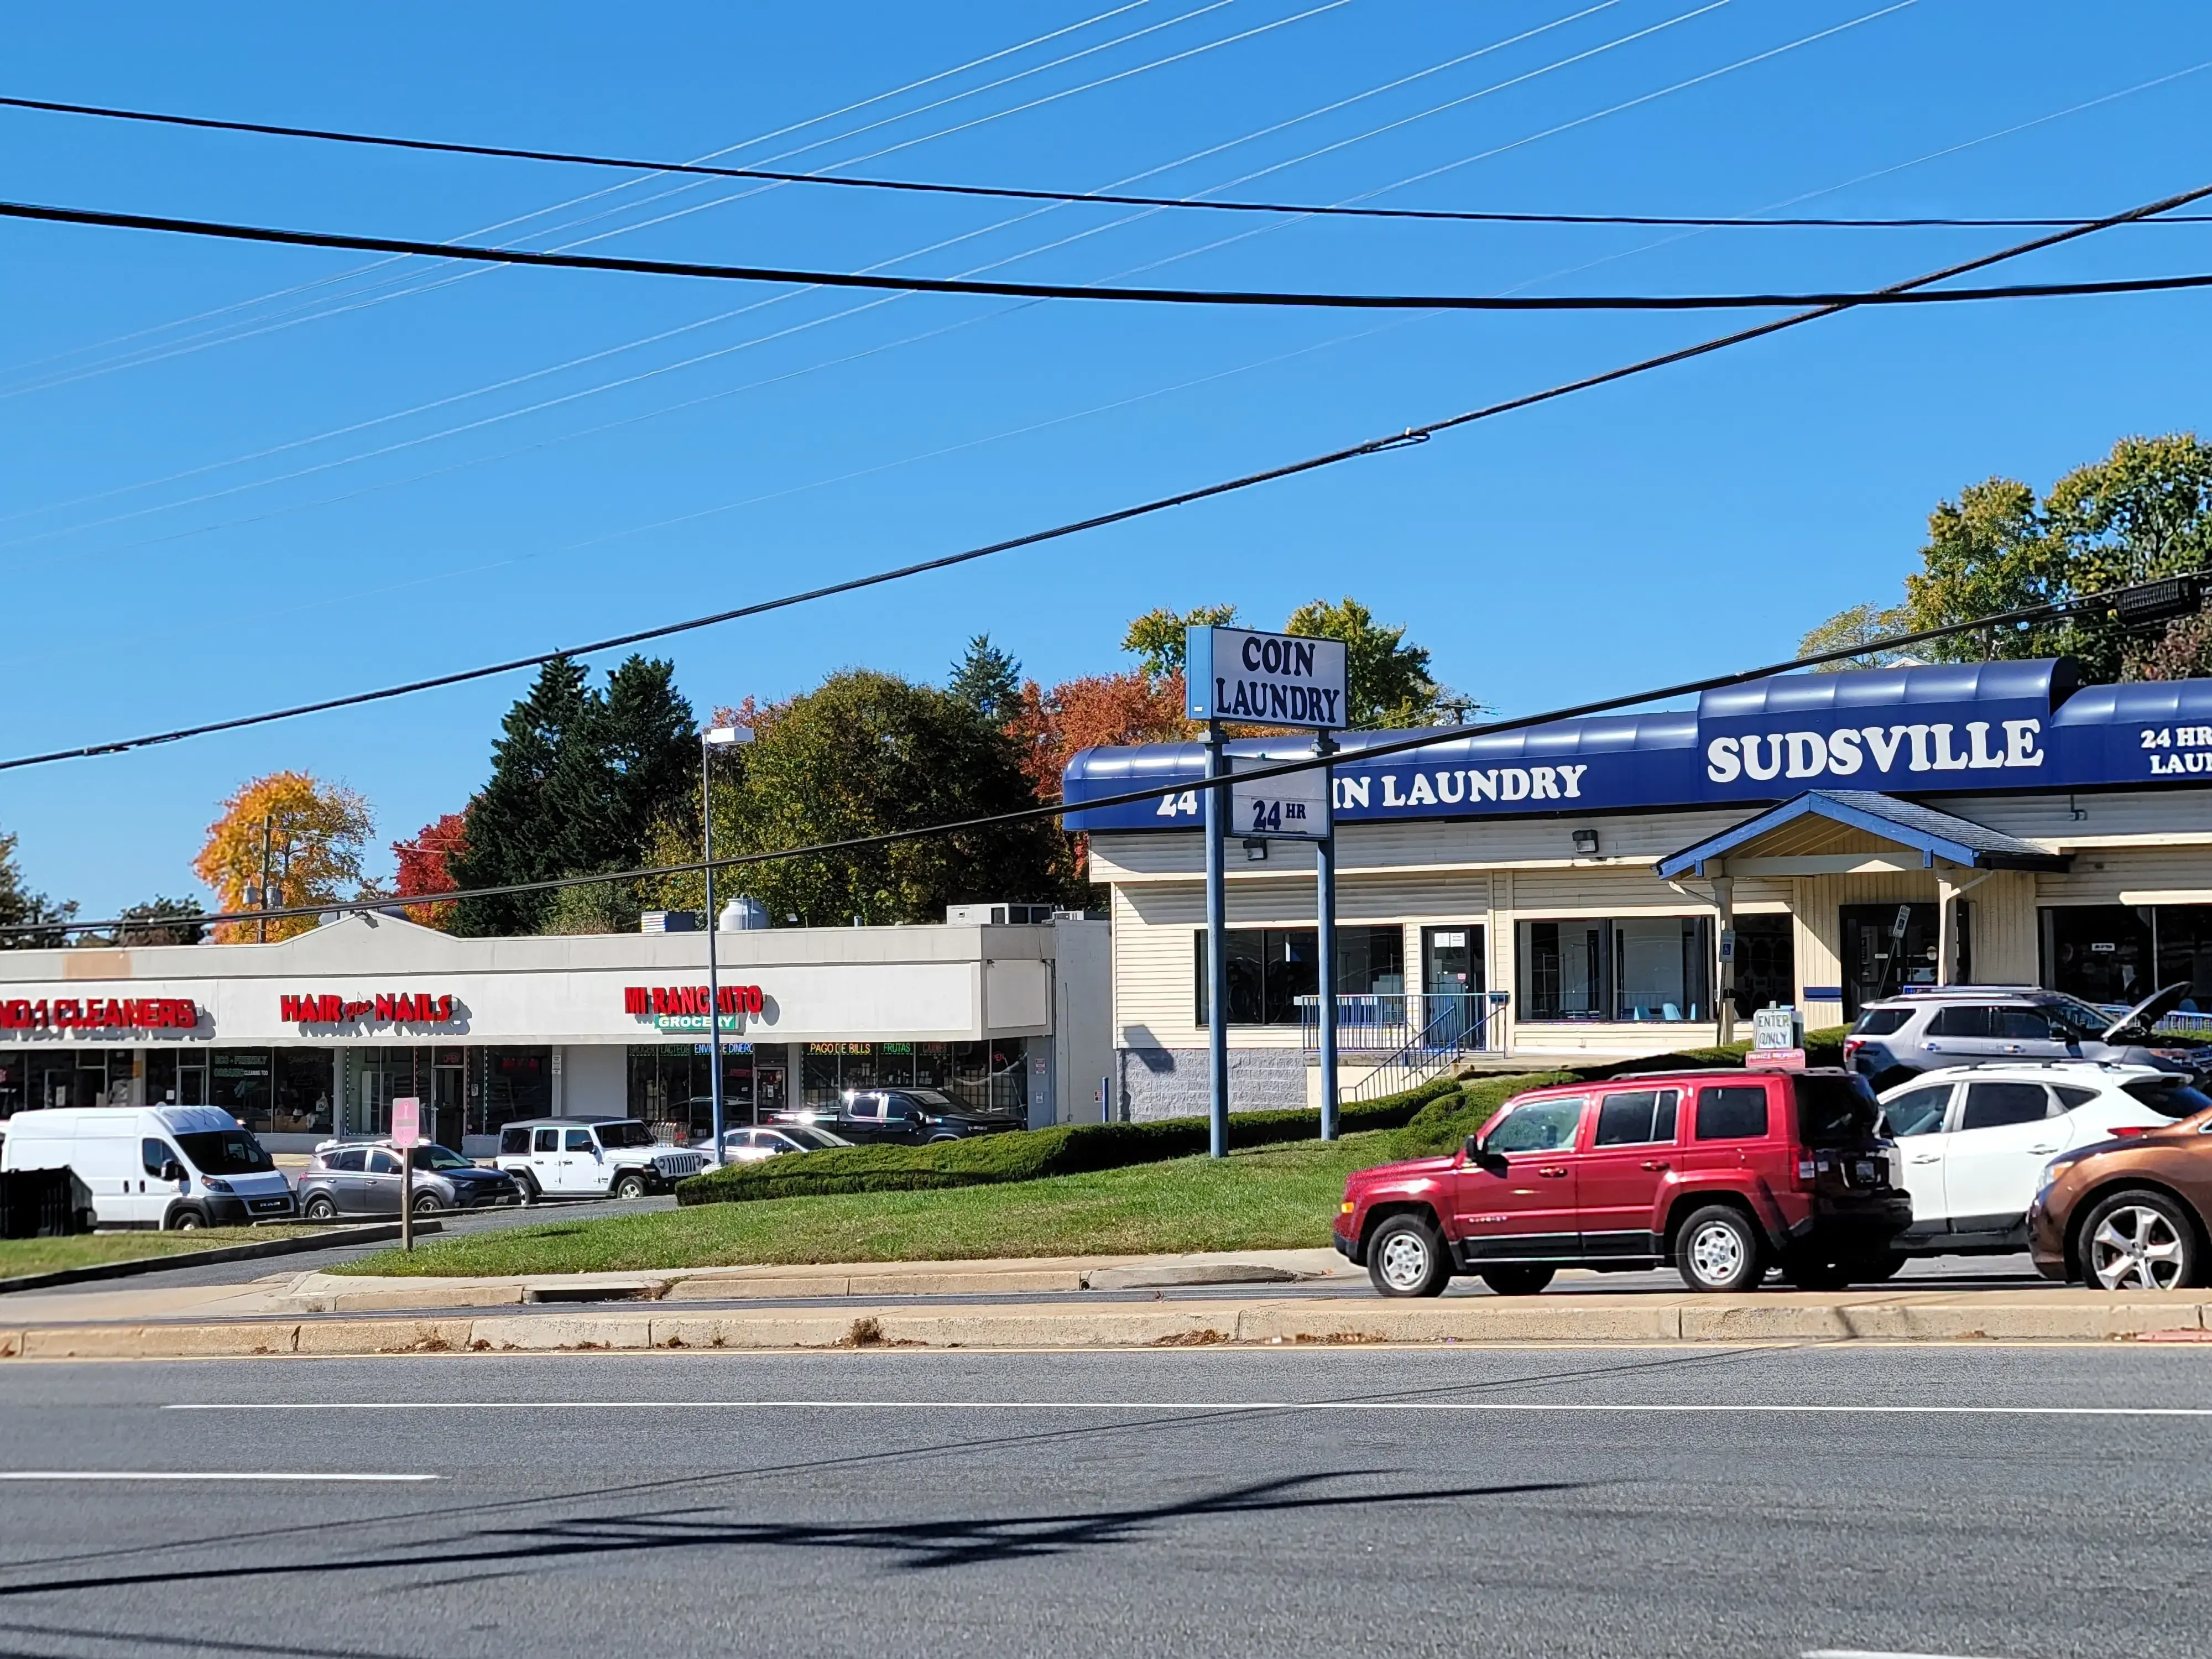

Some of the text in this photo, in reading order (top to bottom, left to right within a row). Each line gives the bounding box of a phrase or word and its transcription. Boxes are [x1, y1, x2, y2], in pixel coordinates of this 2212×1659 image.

[1242, 637, 1316, 677] COIN
[1215, 677, 1340, 723] LAUNDRY
[1708, 718, 2044, 782] SUDSVILLE
[2141, 728, 2172, 749] 24
[1156, 765, 1588, 817] 24 IN LAUNDRY
[1253, 800, 1306, 831] 24 HR
[54, 998, 198, 1029] CLEANERS
[280, 994, 344, 1022] HAIR
[375, 993, 453, 1021] NAILS
[625, 987, 649, 1014] MI
[810, 1043, 834, 1053] PAGO
[849, 1044, 870, 1054] BILLS
[883, 1042, 911, 1053] FRUTAS
[1759, 1031, 1787, 1045] ONLY
